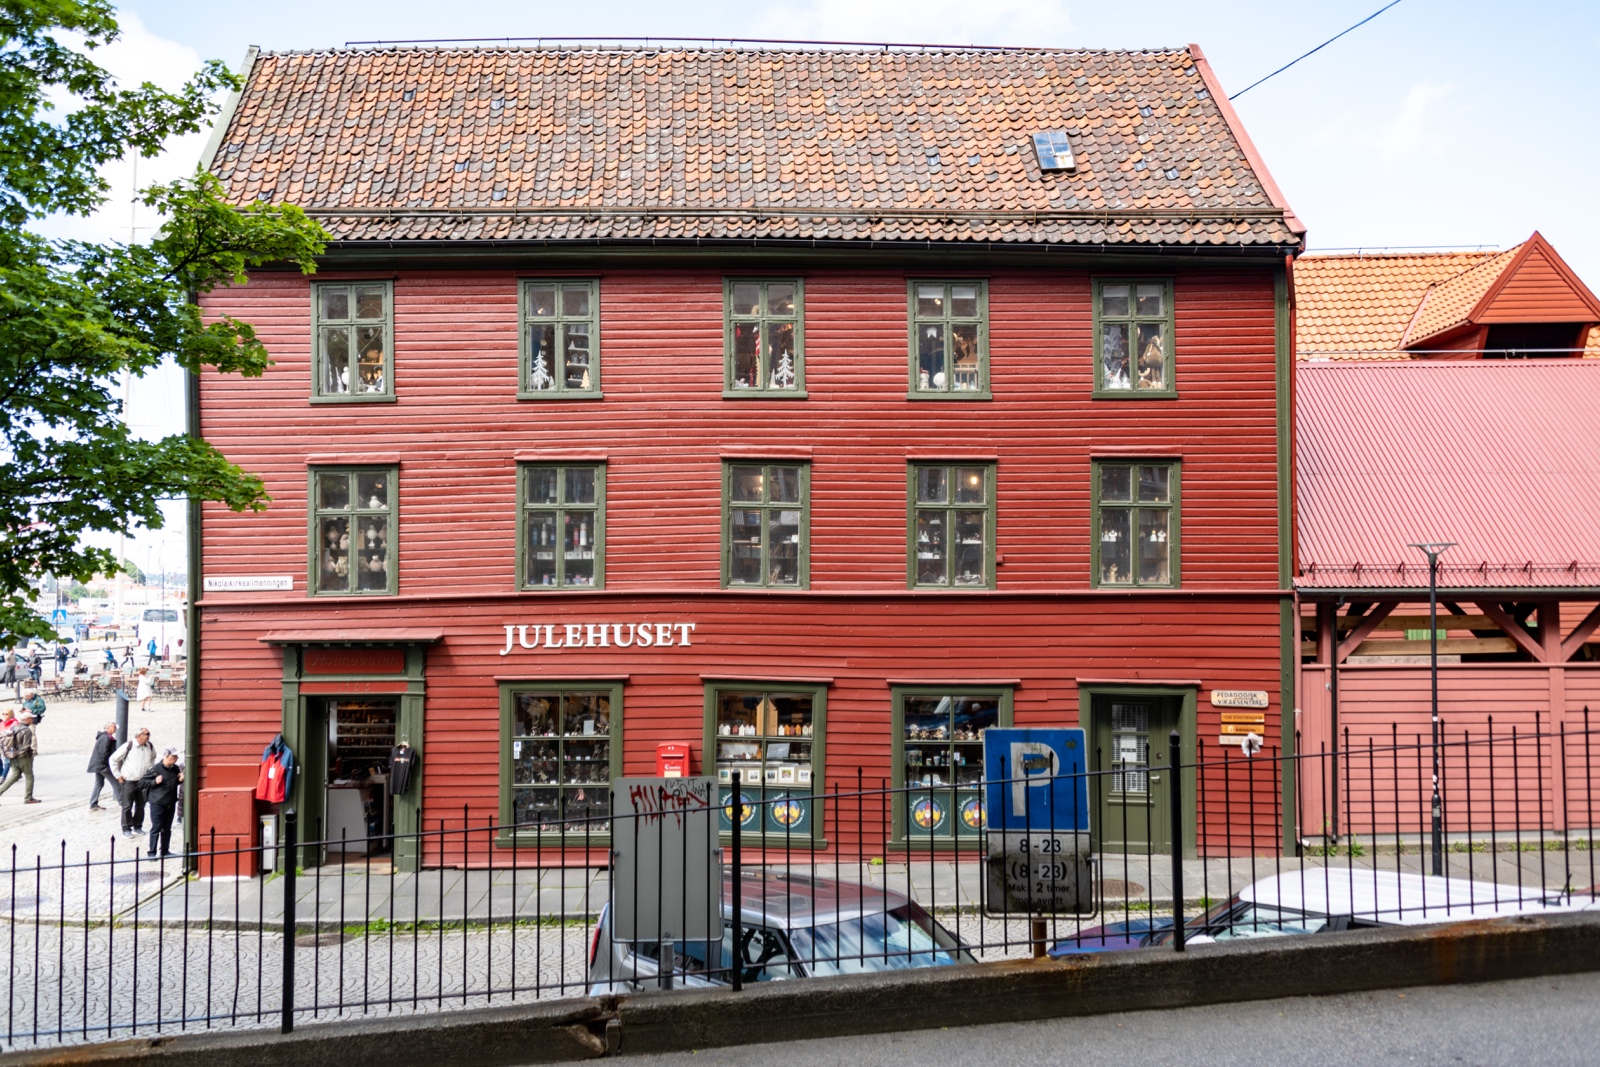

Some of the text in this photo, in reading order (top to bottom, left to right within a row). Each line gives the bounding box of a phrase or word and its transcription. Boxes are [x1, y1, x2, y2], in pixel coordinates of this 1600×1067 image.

[208, 579, 288, 588] Nikolaikirkeallmenningen
[500, 623, 695, 655] JULEHUSET
[1216, 691, 1258, 699] PEDAGOGISK
[1010, 742, 1060, 816] P
[1036, 882, 1044, 893] 2
